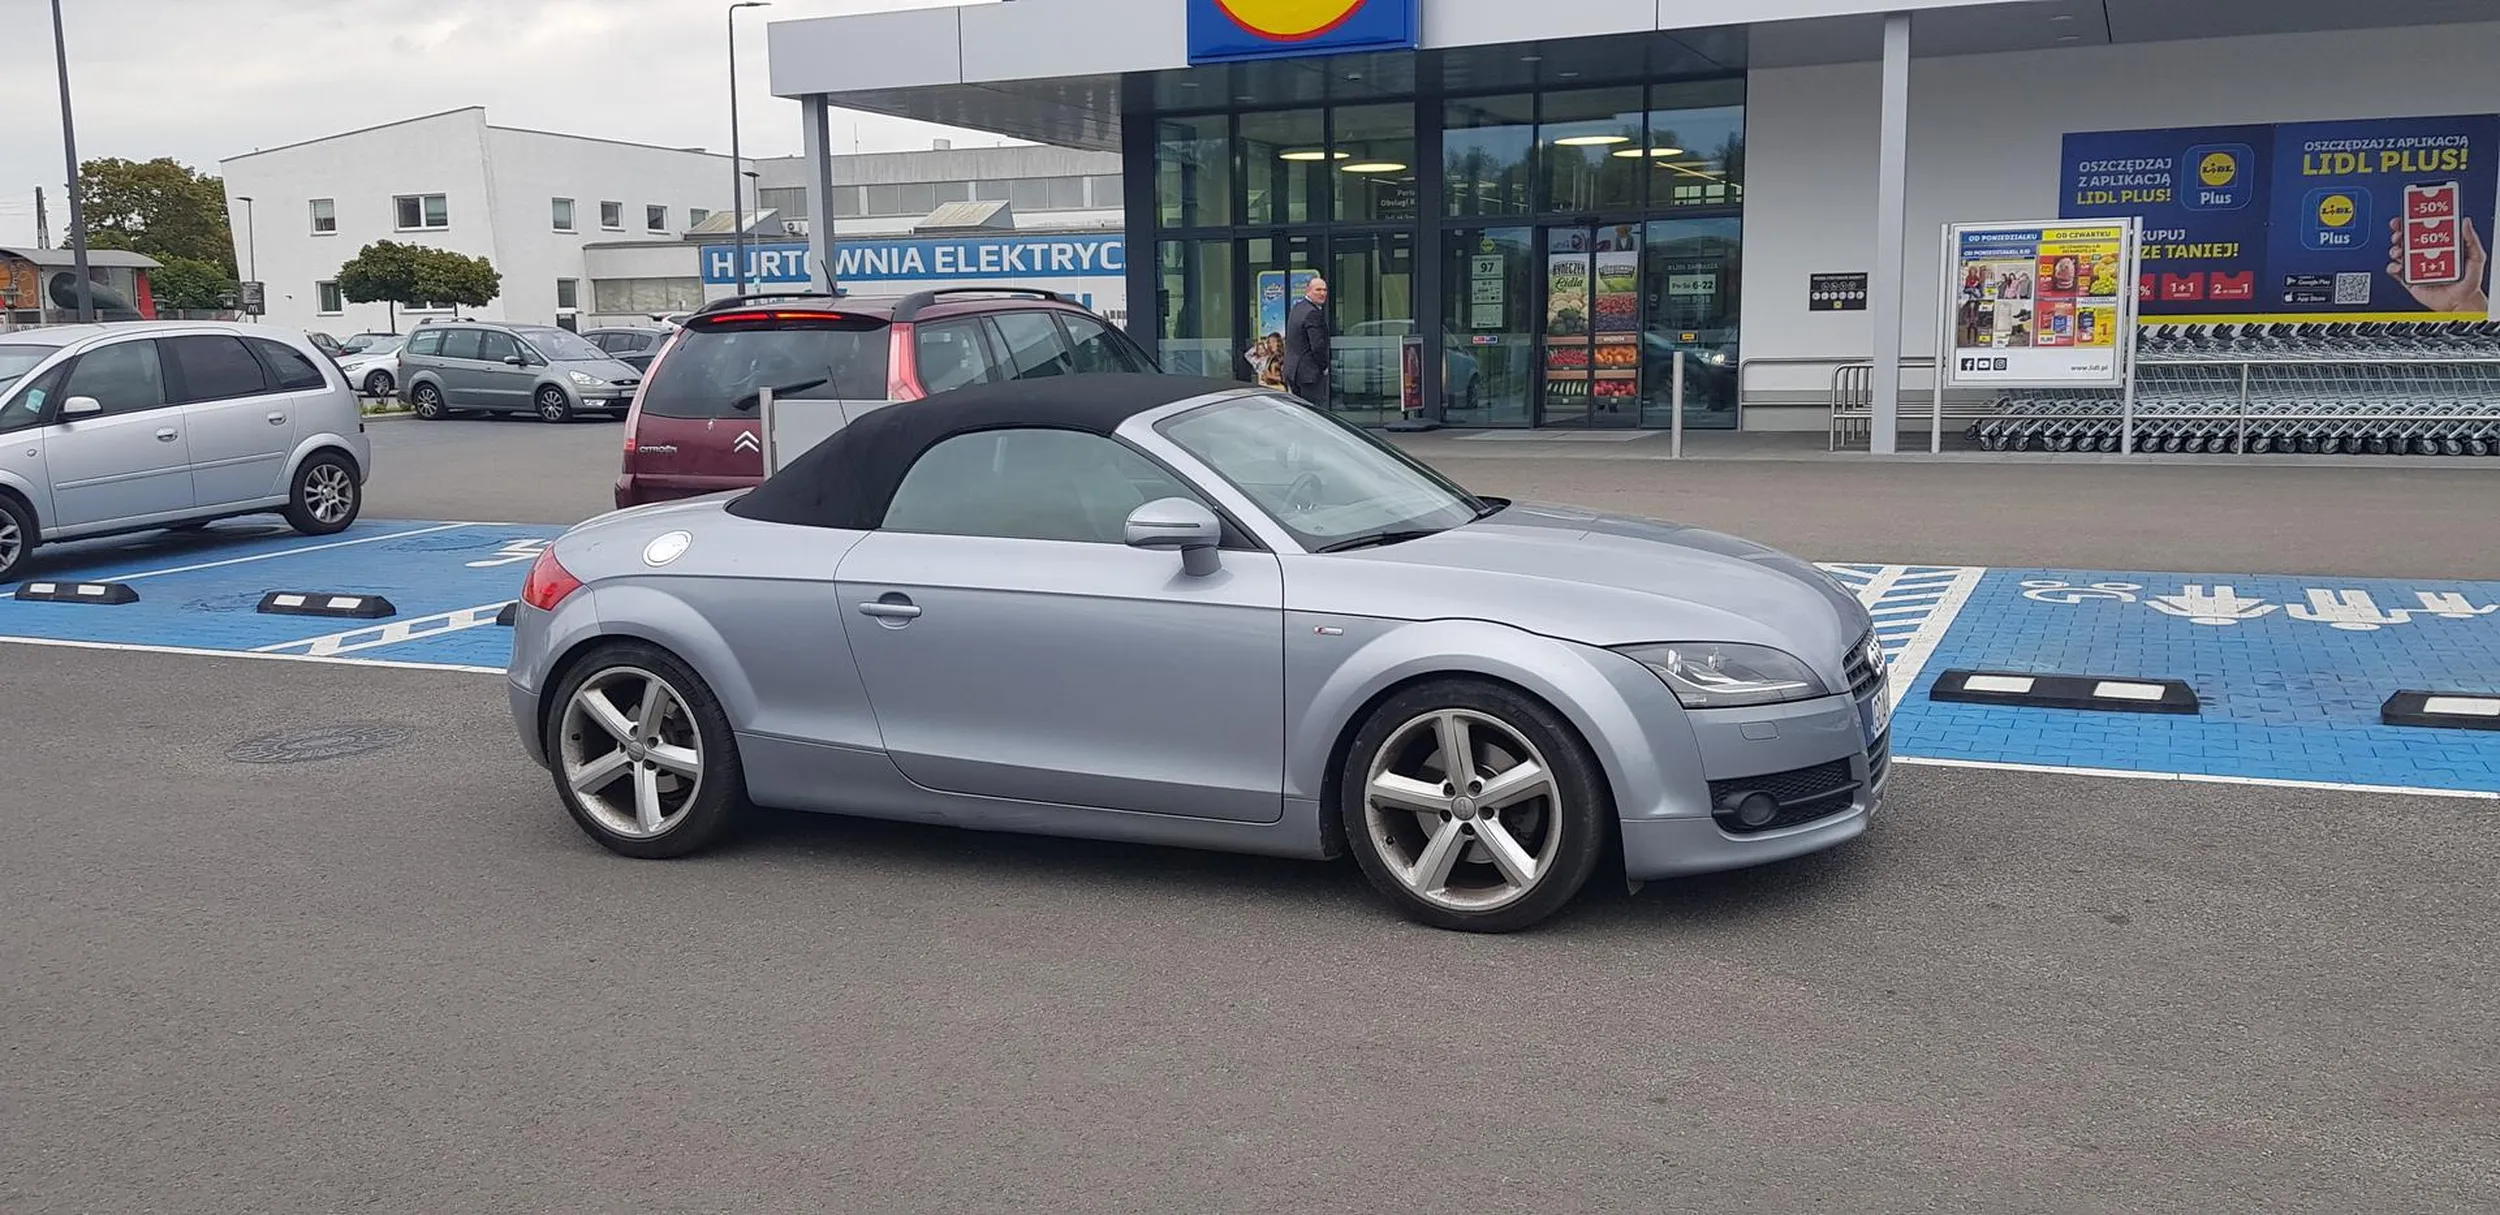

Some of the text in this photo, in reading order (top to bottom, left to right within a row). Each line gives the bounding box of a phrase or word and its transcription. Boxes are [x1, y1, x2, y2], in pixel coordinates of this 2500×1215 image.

[2304, 135, 2469, 152] OSZCZĘDZAJ Z APLIKACJĄ
[2079, 158, 2173, 174] OSZCZĘDZAJ
[2303, 148, 2469, 176] LIDL PLUS!
[2078, 173, 2171, 188] Z APLIKACJĄ
[2077, 189, 2172, 205] LIDL PLUS!
[2200, 192, 2232, 205] Plus
[2414, 201, 2449, 213] -50%
[1968, 235, 1980, 243] OD
[2069, 230, 2111, 238] CZWARTKU
[2319, 232, 2351, 245] Plus
[2414, 231, 2450, 244] -60%
[2165, 242, 2240, 259] TANIEJ!
[711, 241, 1125, 278] HURTWNIA ELEKTRYC
[1480, 262, 1495, 273] 97
[2420, 260, 2446, 273] 1+1
[2169, 281, 2195, 294] 1+1
